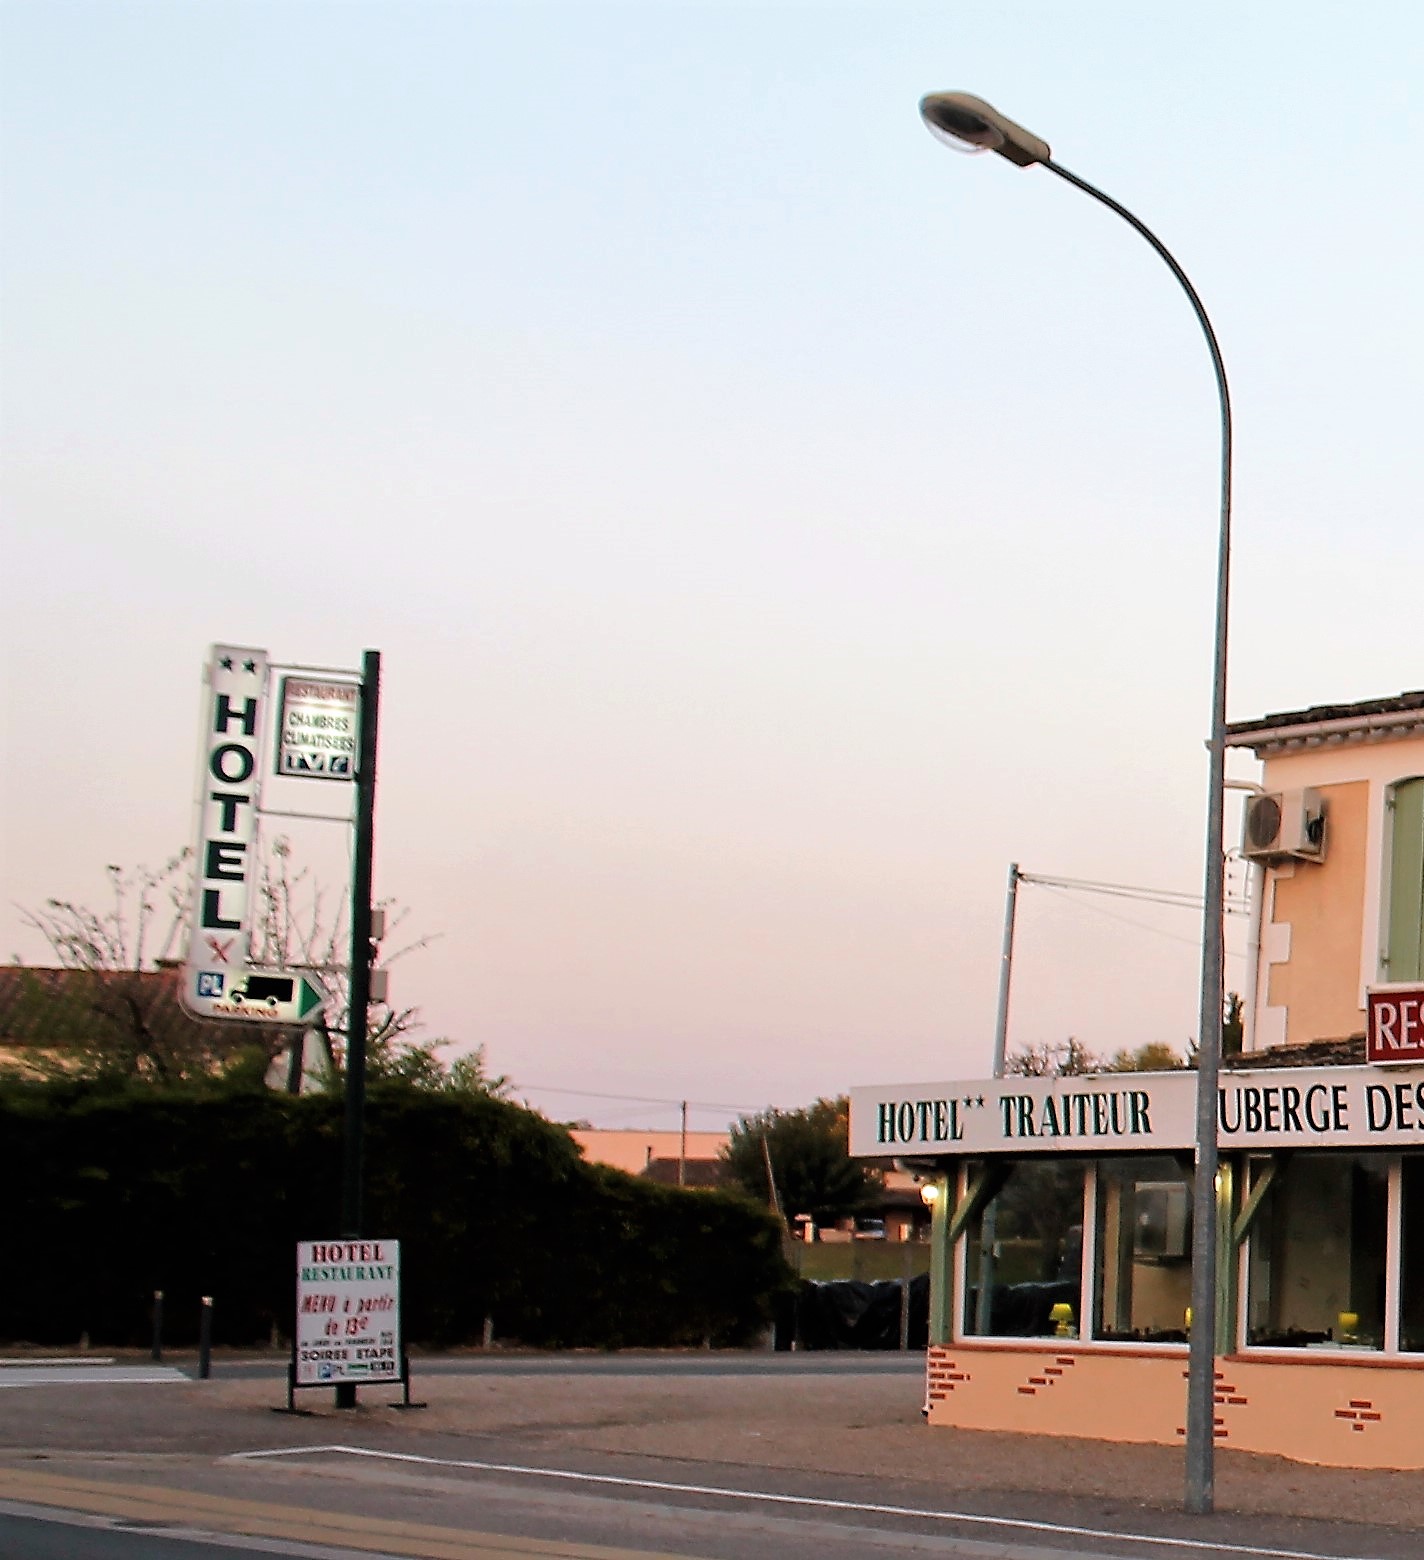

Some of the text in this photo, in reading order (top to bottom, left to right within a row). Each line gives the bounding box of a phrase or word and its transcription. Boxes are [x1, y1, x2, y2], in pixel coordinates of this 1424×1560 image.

[288, 711, 349, 732] CHAMBRES
[203, 694, 257, 929] HOTEL
[877, 1090, 1152, 1143] HOTEL TRAITEUR
[1219, 1084, 1350, 1134] UBERGE
[313, 1244, 384, 1262] HOTEL
[302, 1265, 393, 1281] RESTAURANT
